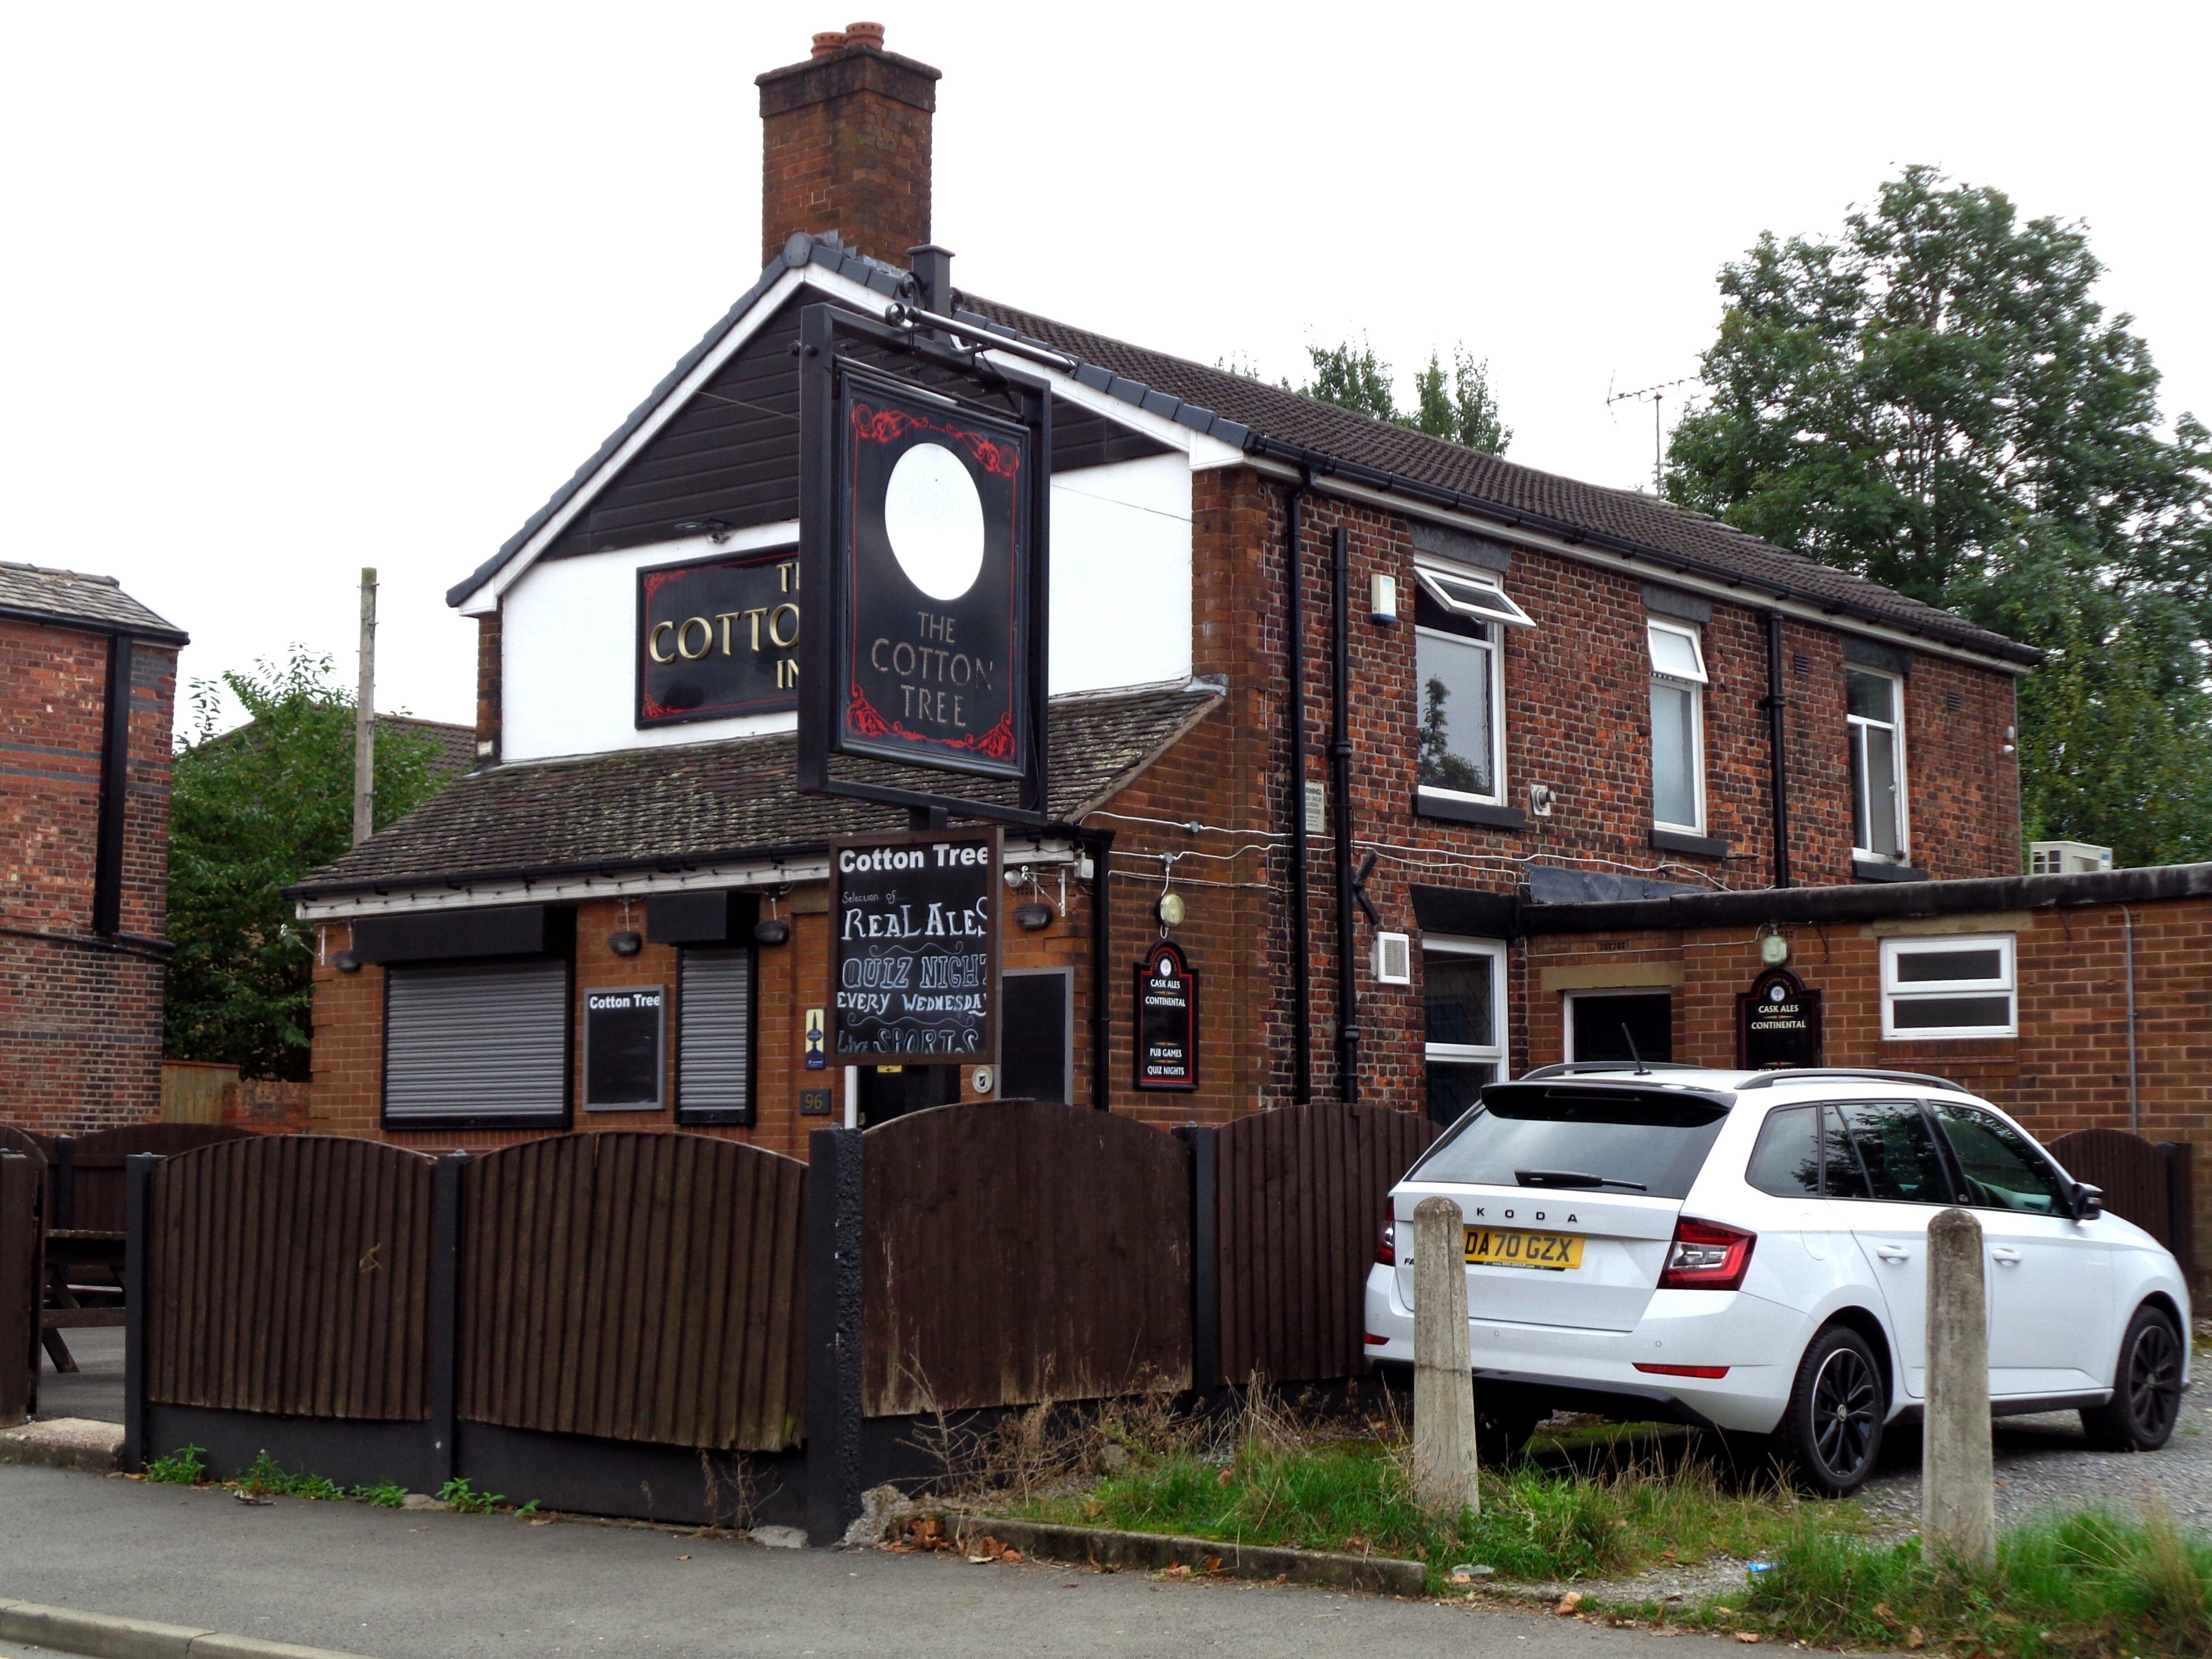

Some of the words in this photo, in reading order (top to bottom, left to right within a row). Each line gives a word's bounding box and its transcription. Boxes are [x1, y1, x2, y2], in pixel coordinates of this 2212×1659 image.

[650, 603, 799, 663] COTTO
[918, 611, 955, 643] THE
[872, 638, 994, 691] COTTON
[901, 684, 966, 726] TREE
[839, 847, 924, 873] Cotton
[933, 843, 988, 867] Tree
[842, 891, 879, 904] Selection
[842, 957, 913, 989] QUIZ
[1150, 979, 1166, 988] CASK
[1167, 979, 1180, 989] ALES
[590, 995, 630, 1009] Cotton
[633, 994, 660, 1007] Tree
[837, 991, 891, 1015] EVERY
[1145, 996, 1186, 1007] CONTINENTAL
[1758, 1005, 1779, 1013] CASK
[1780, 1004, 1799, 1012] ALES
[1751, 1020, 1806, 1029] CONTINENTAL
[1150, 1048, 1162, 1057] PUB
[1162, 1049, 1182, 1058] GAMES
[1147, 1065, 1162, 1075] QUIZ
[1163, 1066, 1184, 1076] NIGHTS
[805, 1094, 823, 1109] 96
[1477, 1207, 1577, 1223] KODA
[1465, 1231, 1521, 1257] DA70
[1526, 1236, 1573, 1262] GZX
